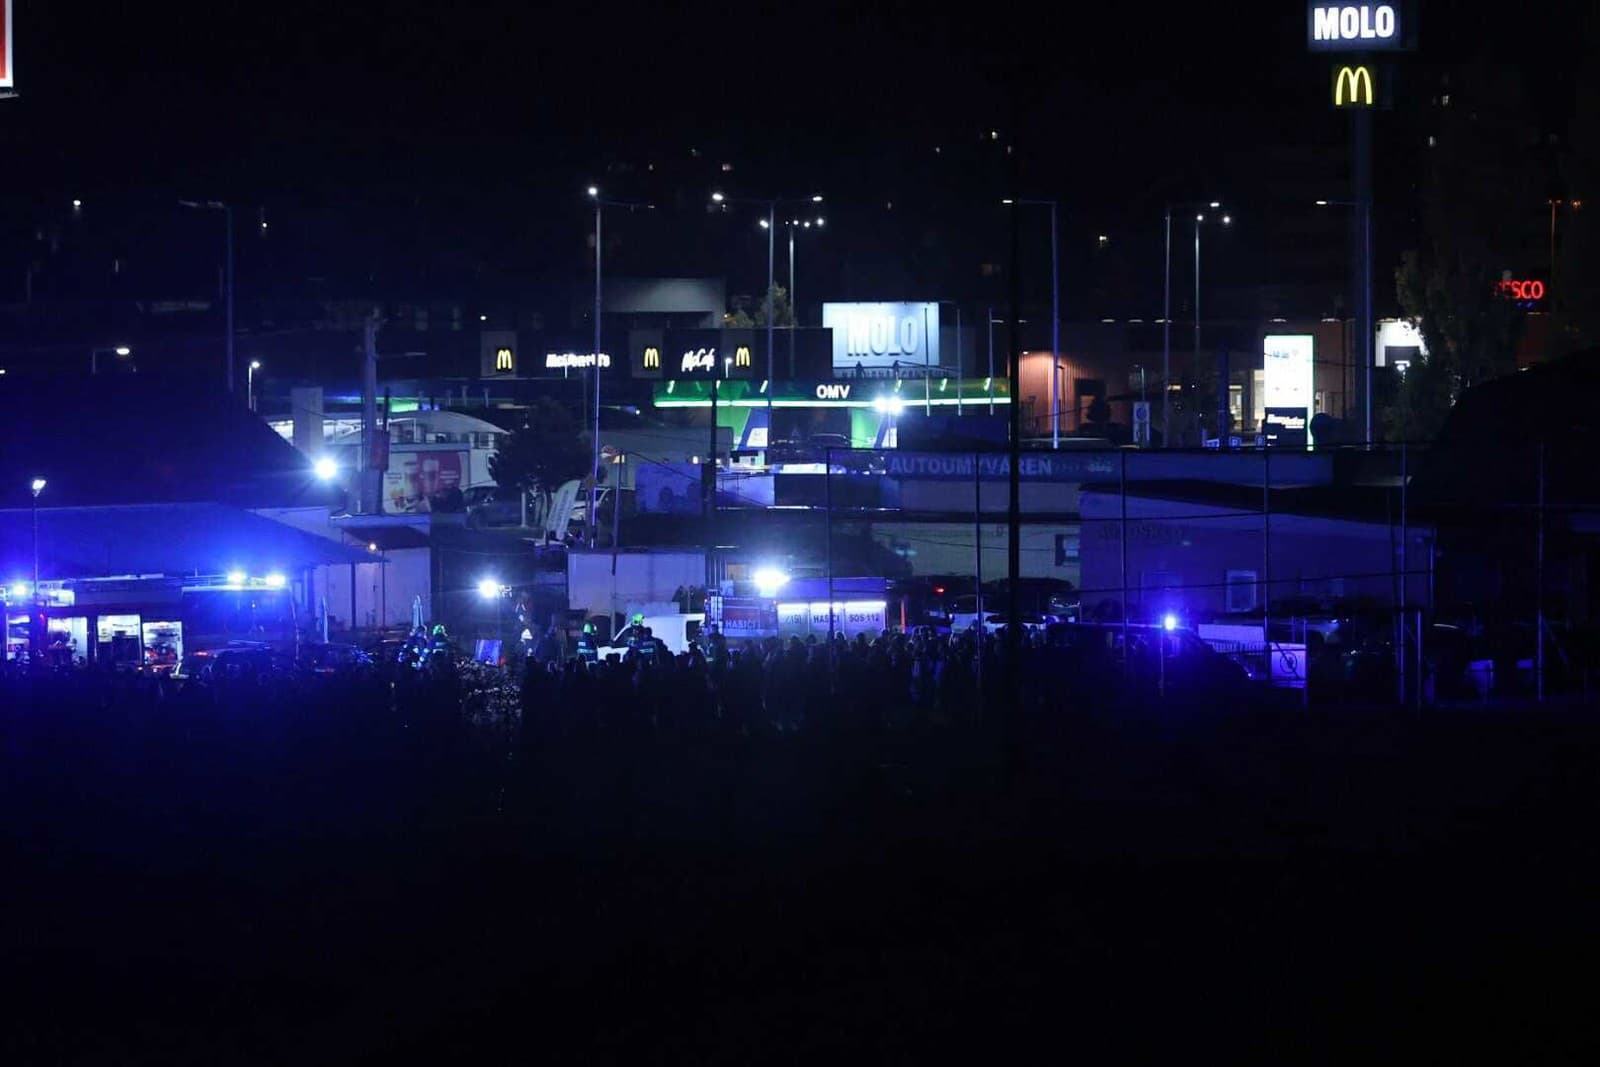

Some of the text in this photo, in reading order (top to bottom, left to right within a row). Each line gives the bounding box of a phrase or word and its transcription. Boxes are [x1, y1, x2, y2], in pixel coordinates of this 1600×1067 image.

[1314, 6, 1394, 40] MOLO
[847, 314, 919, 356] MOLO
[816, 385, 850, 399] OMV
